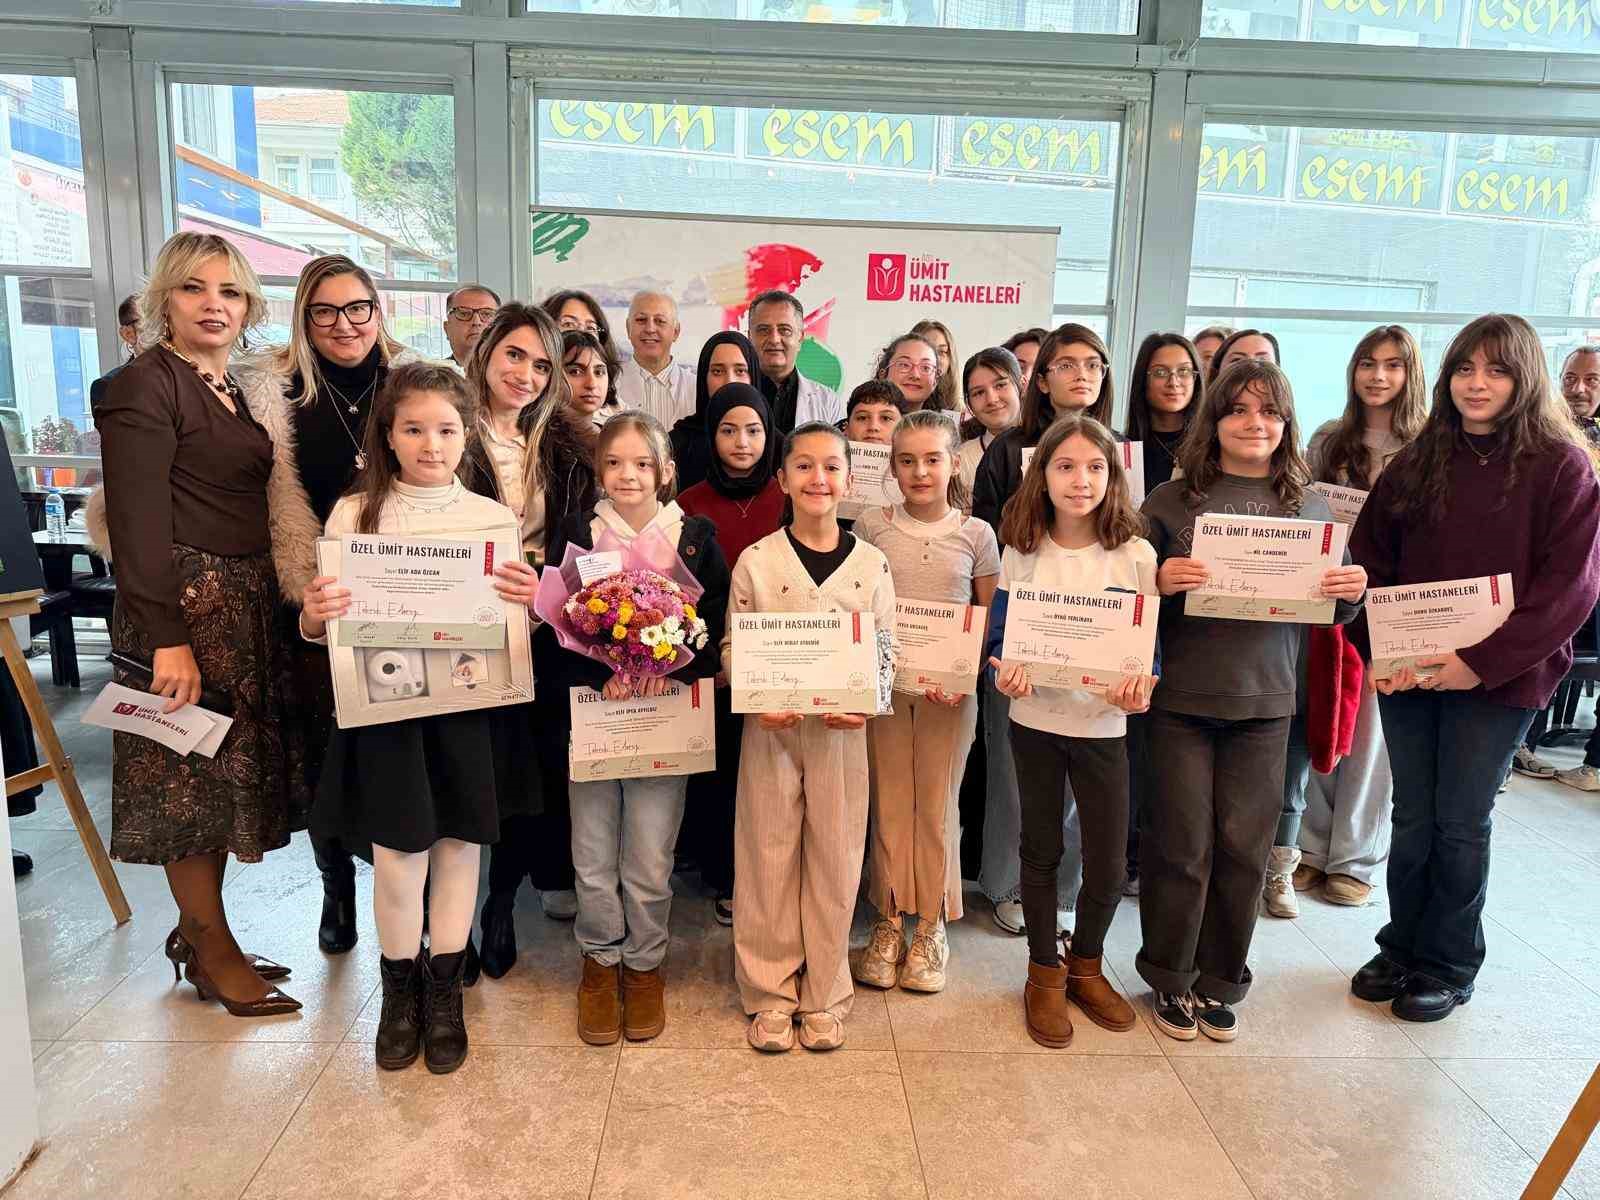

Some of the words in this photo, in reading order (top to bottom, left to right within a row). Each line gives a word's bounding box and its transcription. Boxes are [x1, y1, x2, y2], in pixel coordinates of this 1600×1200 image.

[549, 99, 716, 150] esem
[762, 108, 915, 167] esem
[960, 119, 1101, 174] esem
[1302, 154, 1424, 207] esem
[1456, 168, 1569, 216] esem
[909, 257, 950, 280] ÜMİT
[908, 282, 1021, 304] HASTANELERİ
[1202, 523, 1224, 536] ÖZEL
[1226, 524, 1250, 537] ÜMİT
[1252, 527, 1312, 540] HASTANELERİ
[350, 540, 375, 555] ÖZEL
[378, 541, 403, 556] ÜMİT
[406, 545, 472, 560] HASTANELERİ
[1016, 587, 1036, 601] ÖZEL
[1039, 590, 1061, 603] ÜMİT
[1063, 594, 1123, 611] HASTANELERİ
[1372, 594, 1393, 606] ÖZEL
[1394, 590, 1417, 603] ÜMİT
[1419, 583, 1480, 601] HASTANELERİ
[739, 617, 760, 630] ÖZEL
[761, 617, 782, 630] ÜMİT
[785, 617, 841, 630] HASTANELERİ
[904, 605, 955, 619] HASTANELERİ
[577, 691, 599, 704] ÖZEL
[133, 711, 190, 737] HASTANELERİ
